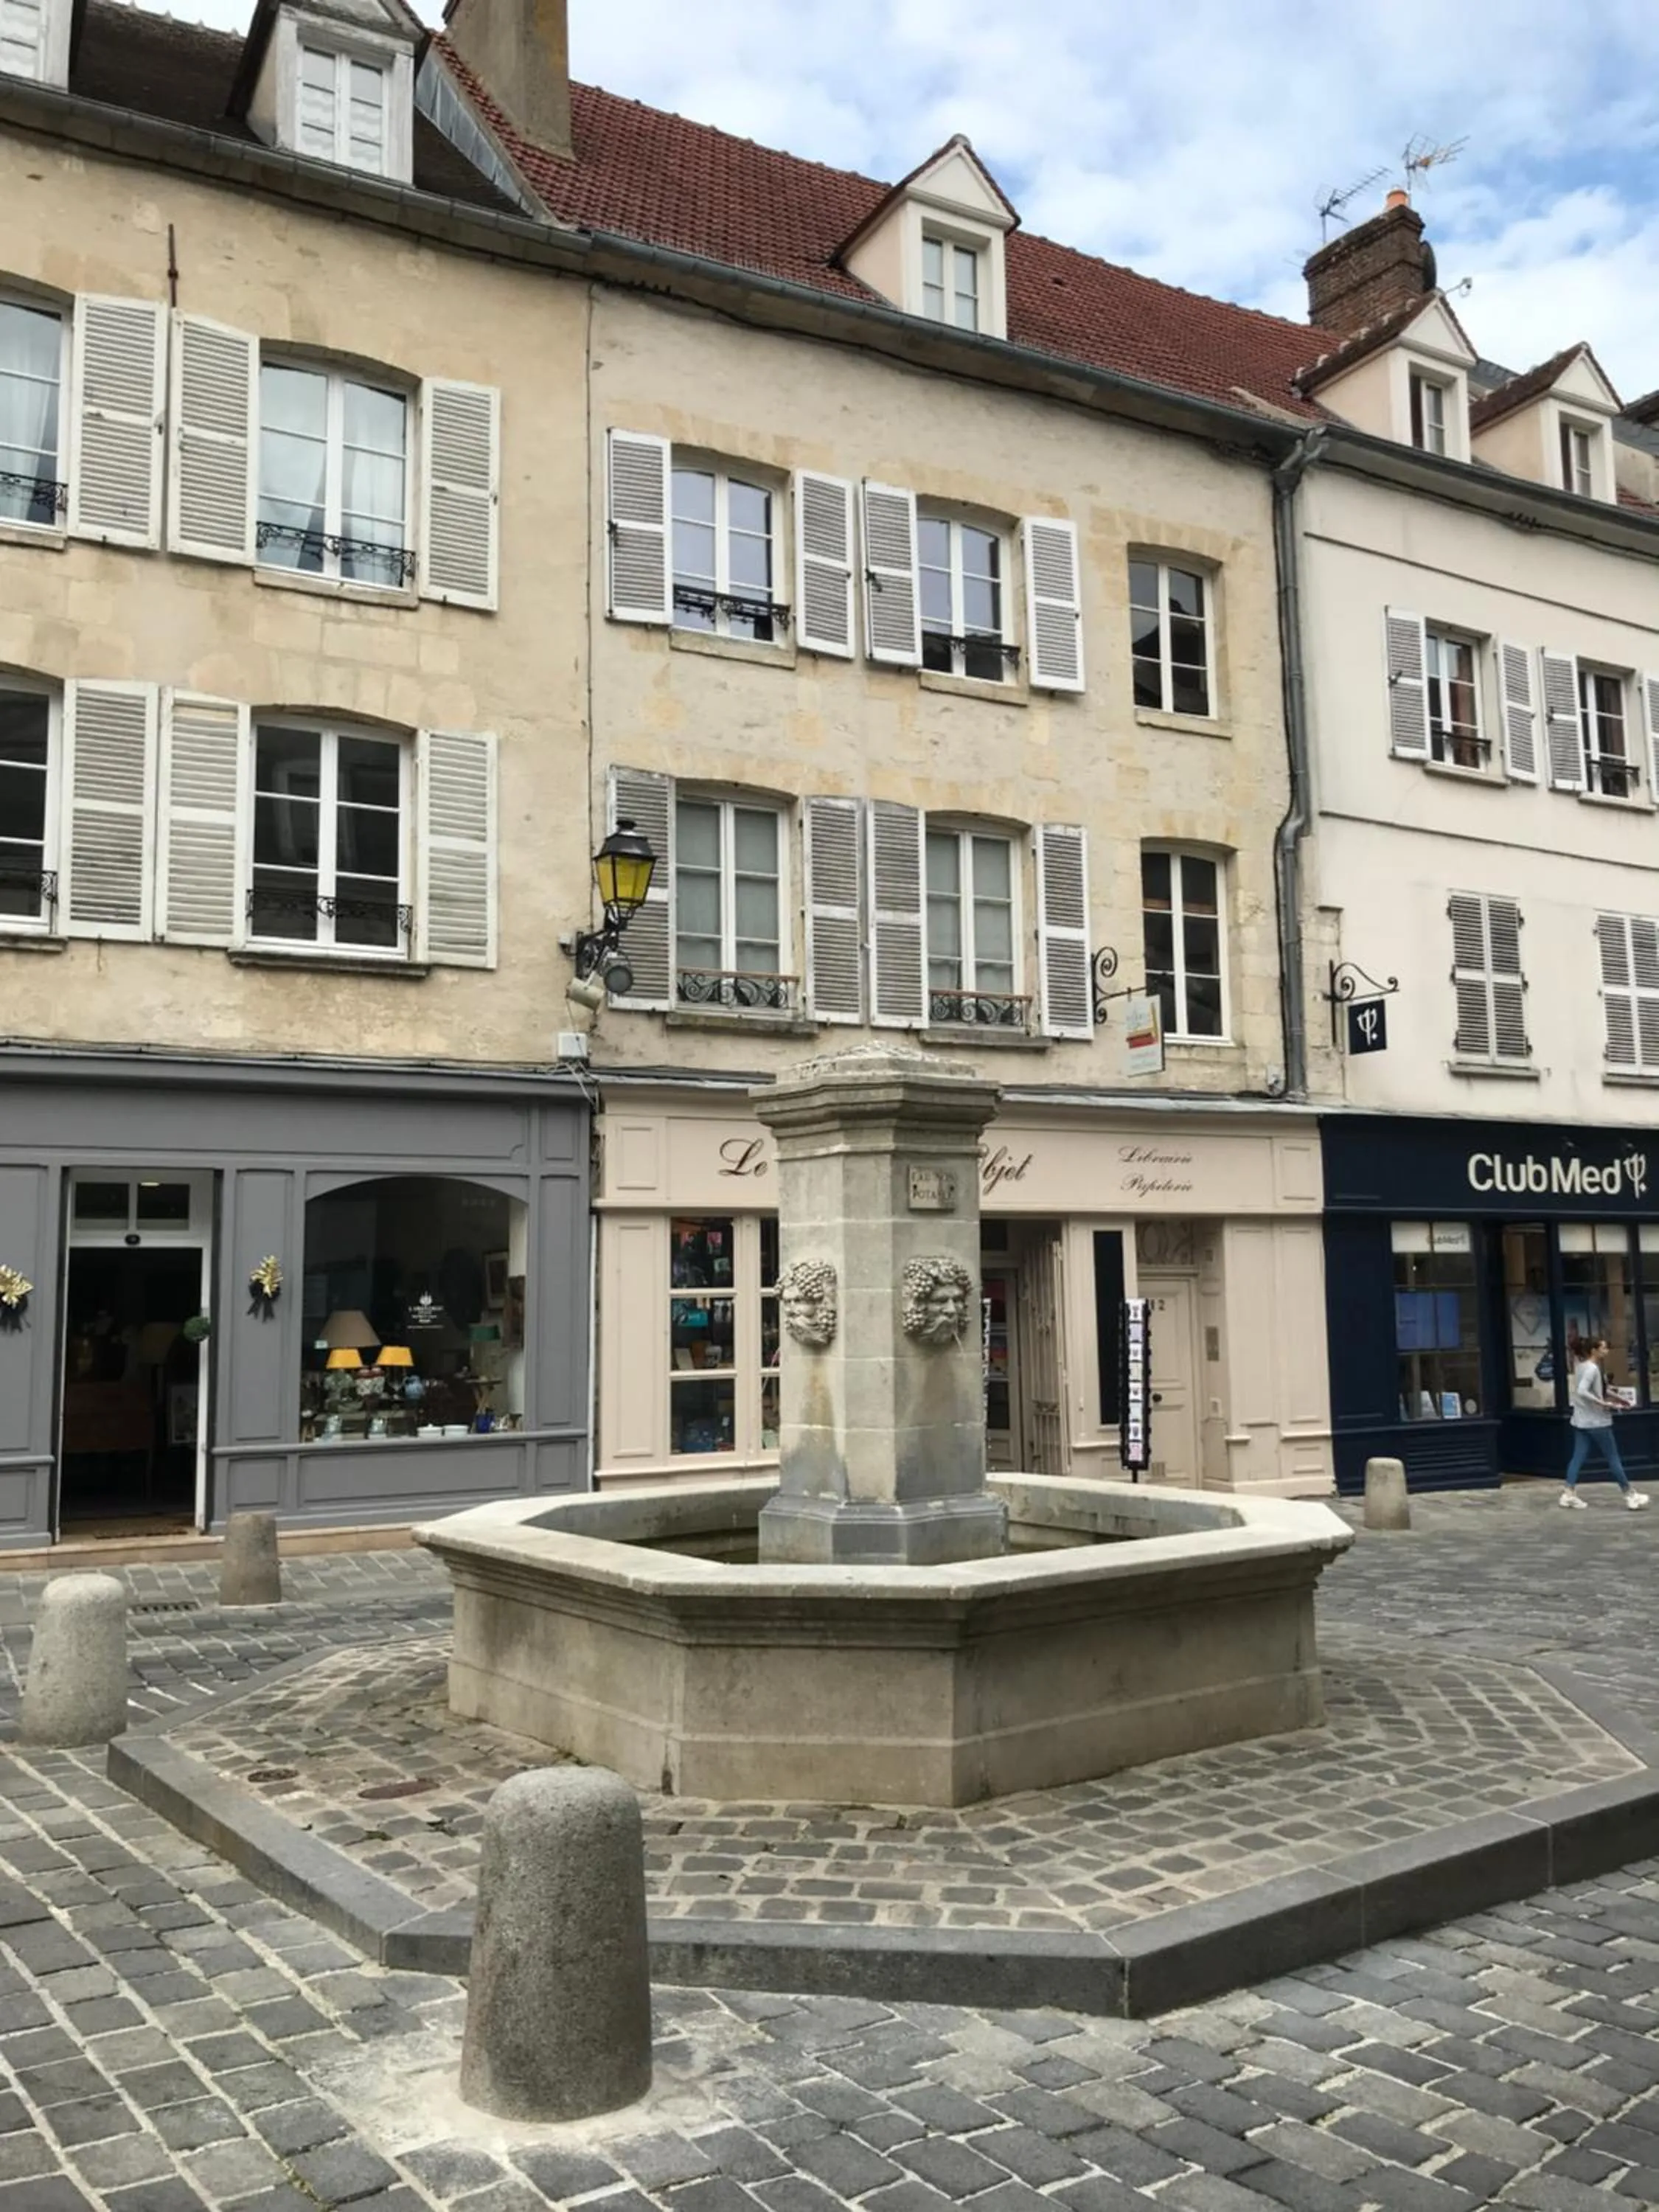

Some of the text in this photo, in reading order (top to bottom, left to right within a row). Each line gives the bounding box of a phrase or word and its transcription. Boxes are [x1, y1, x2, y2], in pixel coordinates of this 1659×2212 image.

[718, 1138, 1034, 1196] Le bjet
[1150, 1298, 1165, 1311] 12
